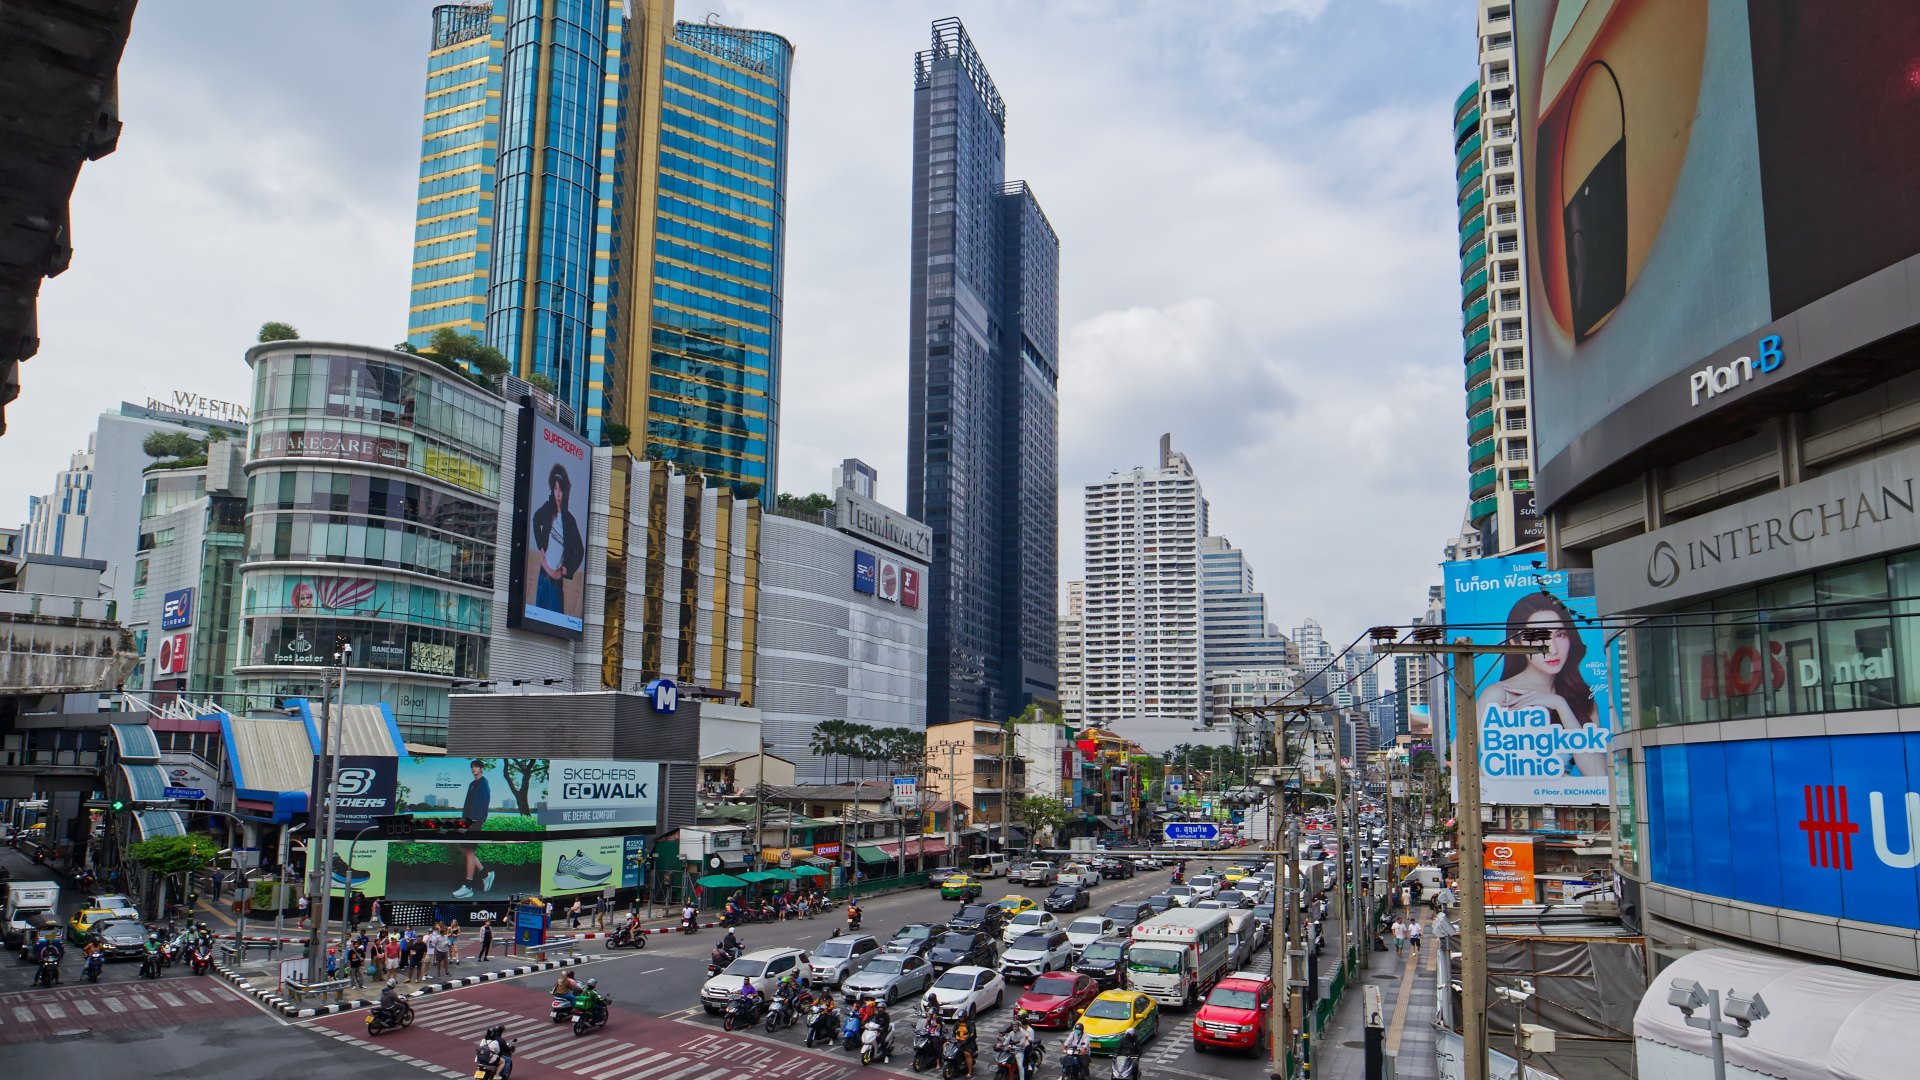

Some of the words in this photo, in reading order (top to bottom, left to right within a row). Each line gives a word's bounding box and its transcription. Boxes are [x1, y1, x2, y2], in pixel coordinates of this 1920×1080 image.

[174, 390, 249, 419] WESTIN
[275, 436, 373, 454] TAKECARE
[1688, 478, 1914, 571] INTERCHAN
[163, 617, 186, 627] CINEMA
[657, 685, 676, 711] M
[1483, 706, 1546, 728] Aura
[1483, 727, 1605, 757] Bangkok
[563, 768, 636, 780] SKECHERS
[1484, 753, 1561, 776] Clinic
[1564, 788, 1607, 796] EXCHANGE
[562, 811, 571, 821] WE
[572, 810, 592, 821] DEFINE
[592, 810, 617, 820] COMFORT
